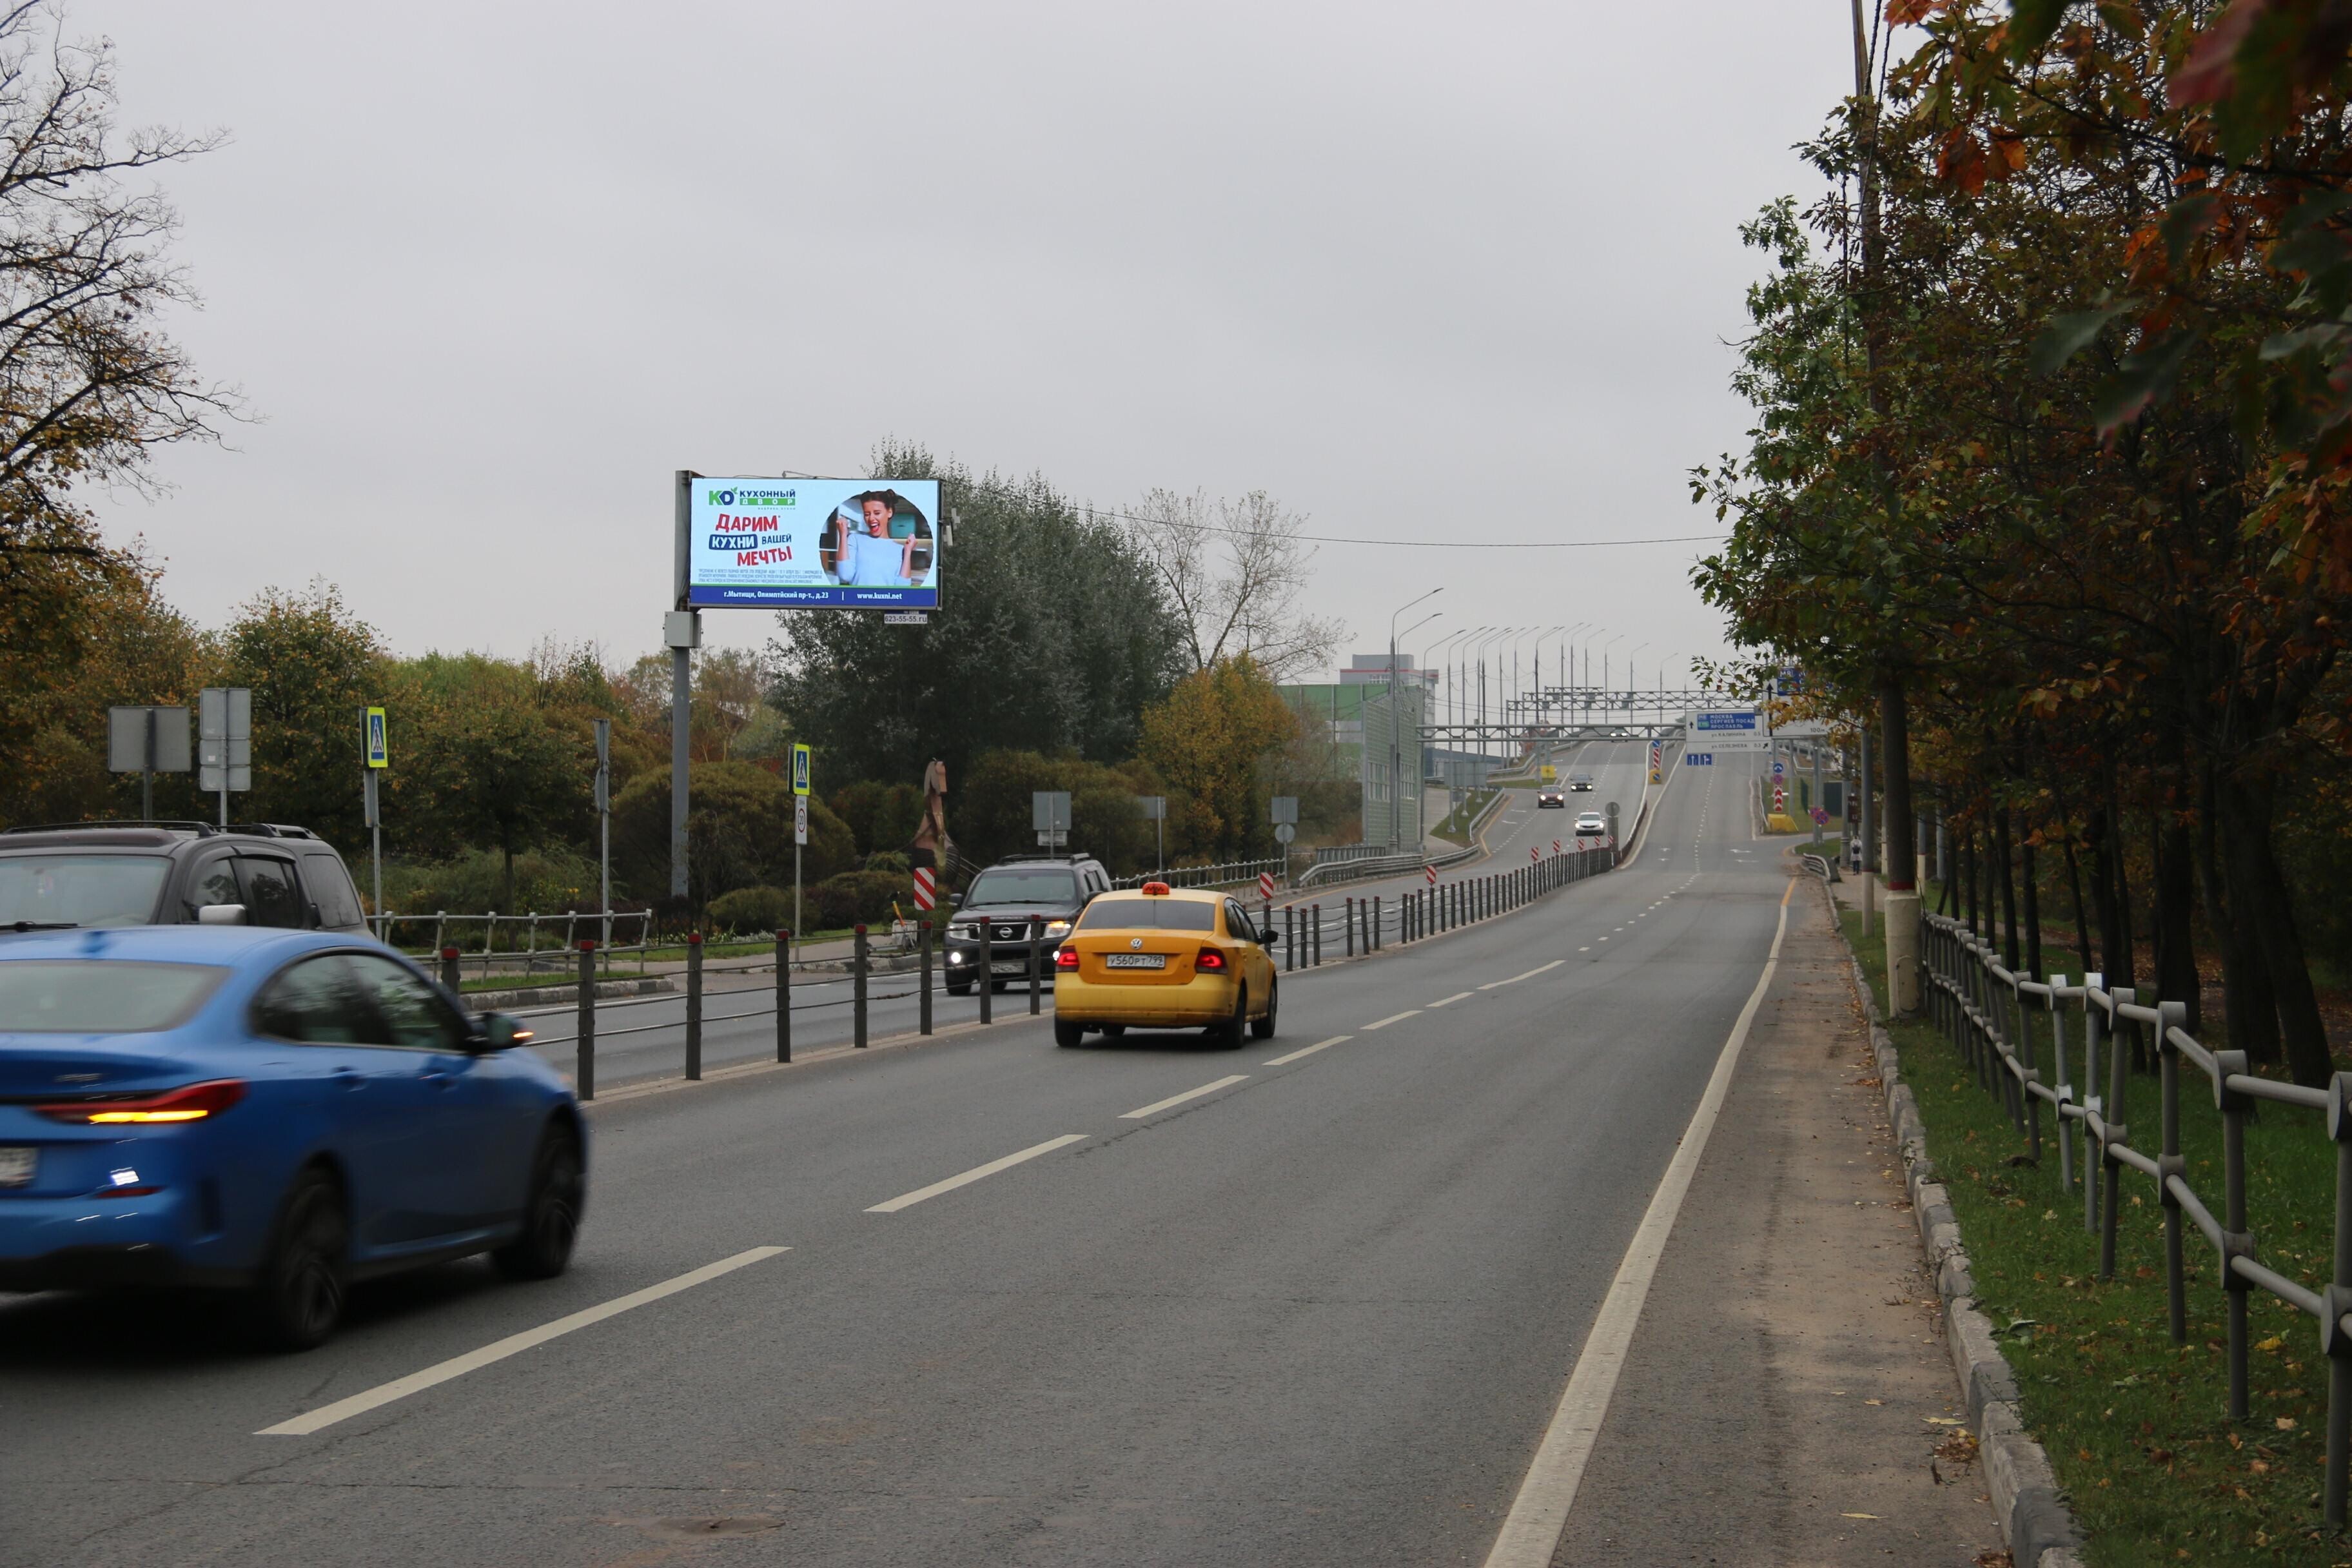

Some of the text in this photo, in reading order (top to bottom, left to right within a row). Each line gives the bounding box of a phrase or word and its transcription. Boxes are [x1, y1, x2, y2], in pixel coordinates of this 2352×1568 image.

[740, 489, 796, 498] КУХОННЫЙ
[711, 534, 792, 549] КУХНИ ВАШЕЙ
[737, 546, 792, 566] МЕЧТЫ
